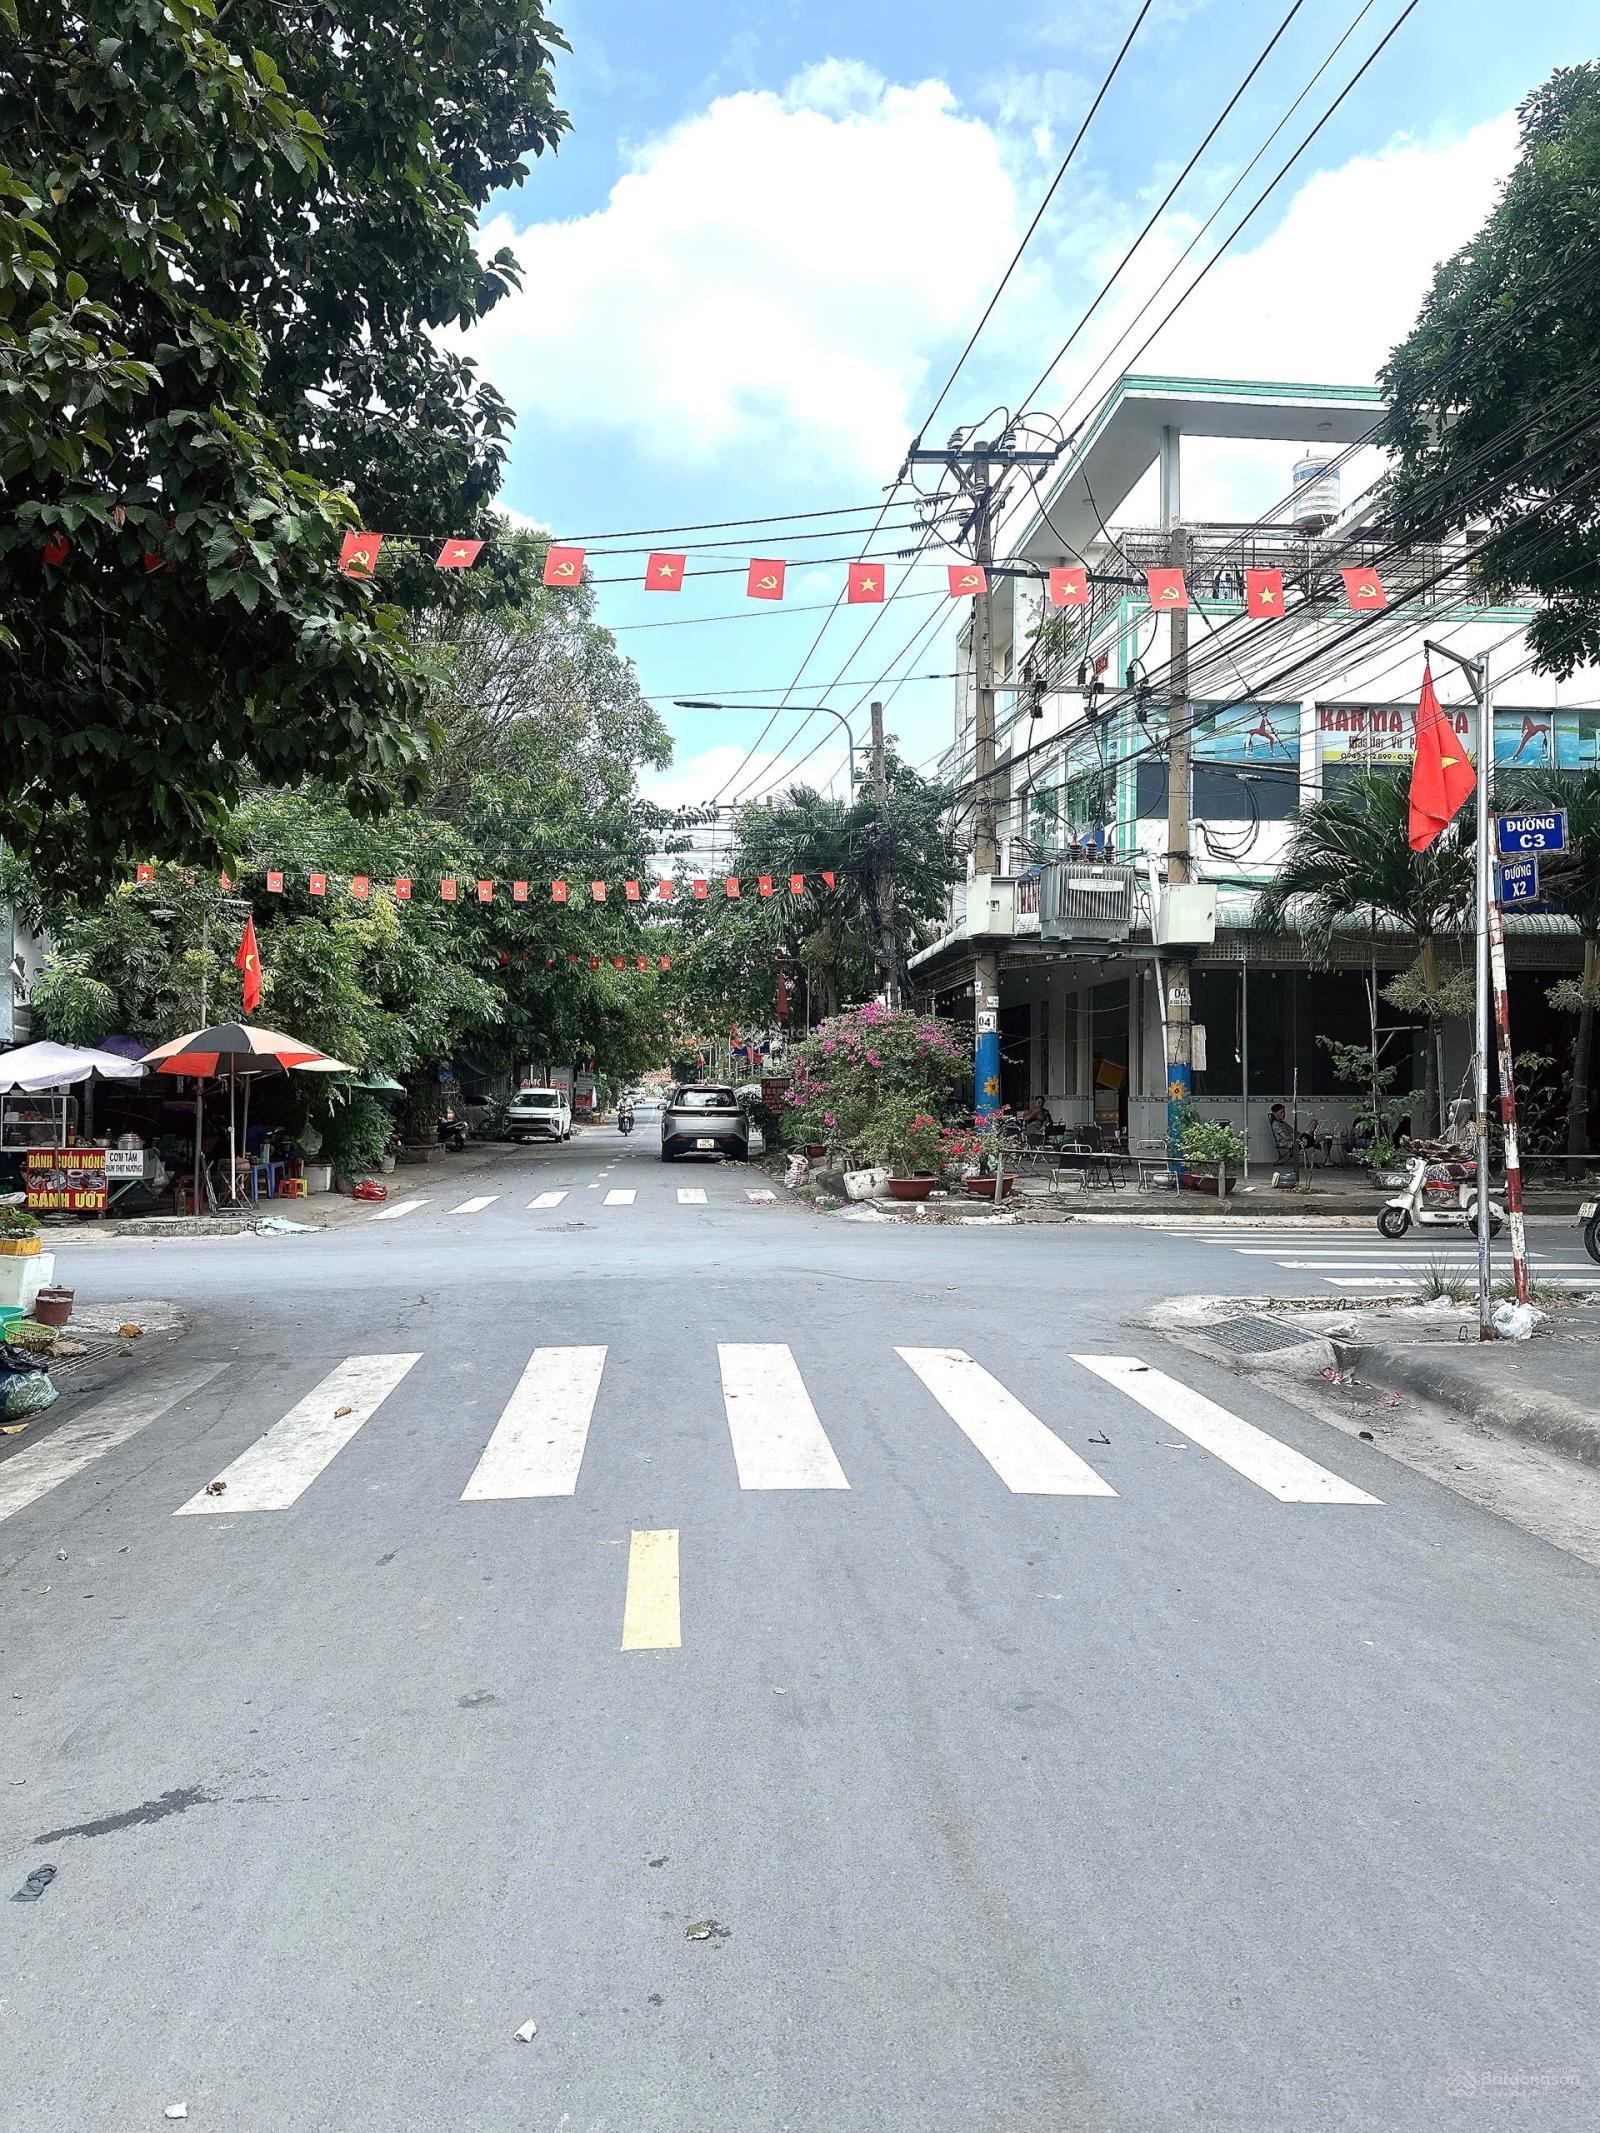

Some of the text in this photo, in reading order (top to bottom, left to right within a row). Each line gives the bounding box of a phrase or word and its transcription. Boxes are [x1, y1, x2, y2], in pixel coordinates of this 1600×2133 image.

[1320, 709, 1403, 732] KARMA
[1506, 816, 1555, 833] ĐƯỜNG
[1519, 833, 1546, 848] C3
[1504, 862, 1532, 881] ĐƯỜNG
[1512, 880, 1527, 898] X2
[1174, 988, 1187, 999] 04
[978, 1016, 991, 1027] 04
[28, 1152, 53, 1168] BÁNH
[82, 1151, 106, 1169] NÓNG
[28, 1190, 106, 1208] BÁNH ƯỚT
